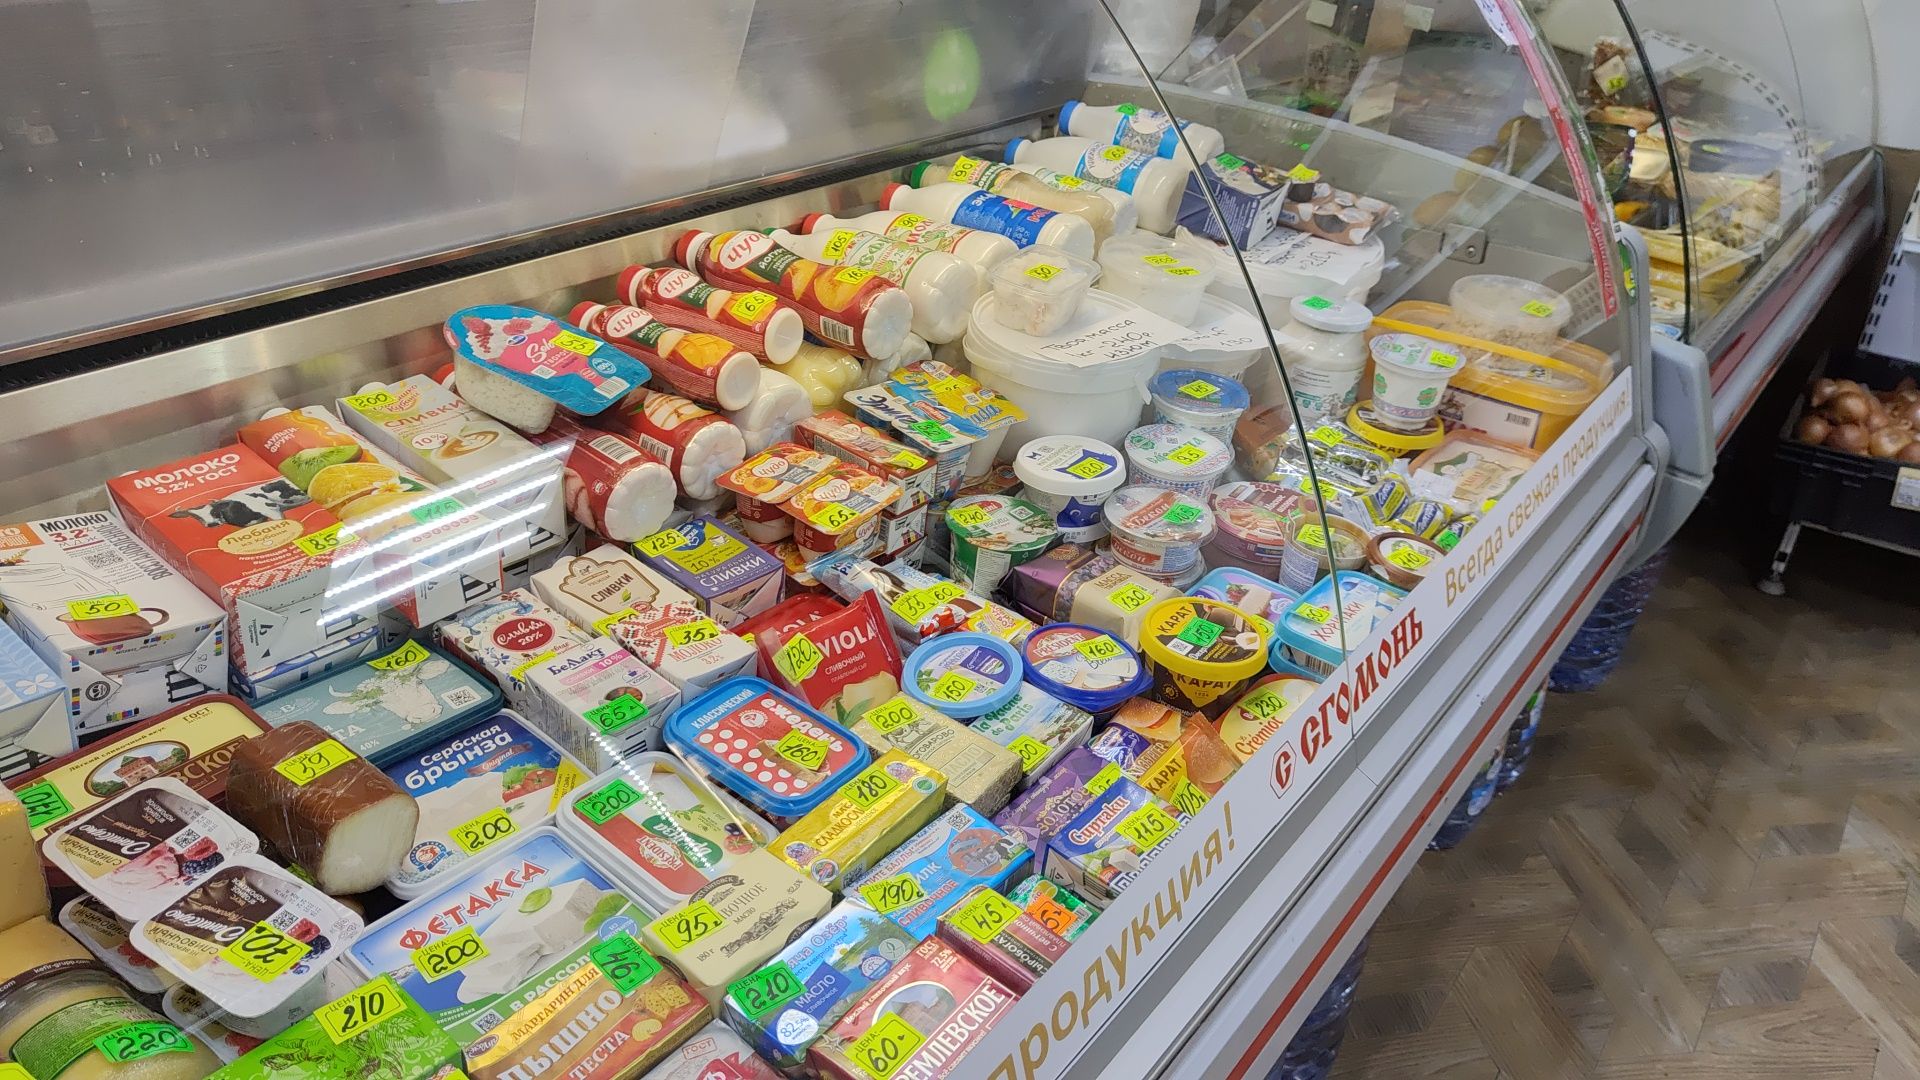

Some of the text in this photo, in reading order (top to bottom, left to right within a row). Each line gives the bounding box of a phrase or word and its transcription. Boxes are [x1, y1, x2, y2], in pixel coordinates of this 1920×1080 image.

[954, 162, 973, 178] 90
[902, 216, 919, 228] 90
[832, 234, 849, 254] 105
[1034, 267, 1052, 280] 50
[744, 295, 765, 312] 65
[560, 339, 586, 351] 55
[355, 393, 388, 408] 200
[384, 400, 465, 428] СЛИВКИ
[269, 433, 296, 453] ФРУКТ
[414, 433, 449, 447] 10%
[133, 453, 241, 490] МОЛОКО
[154, 464, 240, 495] 3,2% ГОСТ
[1079, 462, 1104, 476] 120
[40, 513, 109, 533] МОЛОКО
[828, 510, 849, 527] 65
[959, 511, 985, 525] 240
[223, 519, 292, 545] Любаня
[312, 532, 339, 551] 85
[651, 532, 677, 551] 125
[1445, 525, 1504, 607] Всегда
[1507, 462, 1561, 539] свежая
[690, 557, 721, 573] 10%
[699, 555, 766, 587] СЛИВКИ
[590, 573, 635, 602] СЛИВКИ
[1121, 590, 1145, 608] 130
[85, 602, 121, 615] 50
[1158, 605, 1193, 634] КАРАТ
[497, 619, 546, 646] Сливки
[518, 631, 544, 646] 20%
[679, 627, 706, 646] 35
[816, 619, 878, 659] VIOLA
[386, 651, 418, 669] 160
[598, 652, 624, 668] 10%
[668, 638, 723, 662] МОЛОКО
[787, 638, 818, 675] 120
[1089, 642, 1114, 658] 160
[825, 651, 866, 675] СЛИВОЧНЫЙ
[944, 680, 966, 702] 150
[182, 706, 212, 723] ГОСТ
[600, 707, 627, 729] 65
[691, 688, 757, 730] КЛАССИЧЕСКИЙ
[876, 707, 913, 730] 200
[1254, 696, 1282, 719] 230
[419, 725, 502, 767] Сербская
[782, 743, 816, 763] 160
[404, 732, 514, 790] брынза
[856, 774, 888, 802] 180
[1145, 760, 1182, 795] КАРАТ
[598, 787, 632, 817] 200
[458, 820, 481, 834] ЦЕНА
[1067, 796, 1130, 845] Сиртаки
[1133, 814, 1166, 842] 115
[464, 816, 513, 850] 200
[62, 837, 122, 867] СЛИВОЧНЫЙ
[399, 859, 549, 950] ФЕТАКСА
[879, 879, 915, 909] 190
[898, 879, 959, 927] СЛИВОЧНОЕ
[661, 912, 686, 929] ЦЕНА
[677, 912, 708, 943] 95
[972, 902, 1003, 931] 45
[148, 924, 220, 956] СЛИВОЧНЫЙ
[810, 914, 848, 948] Озёр
[421, 938, 450, 955] ЦЕНА
[427, 937, 481, 974] 200
[696, 950, 709, 963] 180
[735, 974, 762, 990] ЦЕНА
[744, 972, 790, 1010] 210
[795, 973, 836, 1009] МАСЛО
[329, 991, 360, 1012] ЦЕНА
[340, 991, 386, 1033] 210
[510, 986, 575, 1041] МАРГАРИН
[574, 966, 600, 989] ДЛЯ
[806, 986, 839, 1015] СЛИВОЧНОЕ
[105, 1025, 142, 1041] ЦЕНА
[115, 1030, 178, 1060] 220
[498, 988, 636, 1080] ПЫШНО
[568, 1029, 631, 1080] ТЕСТА
[684, 1039, 713, 1058] ГОСТ
[867, 1037, 899, 1073] 60
